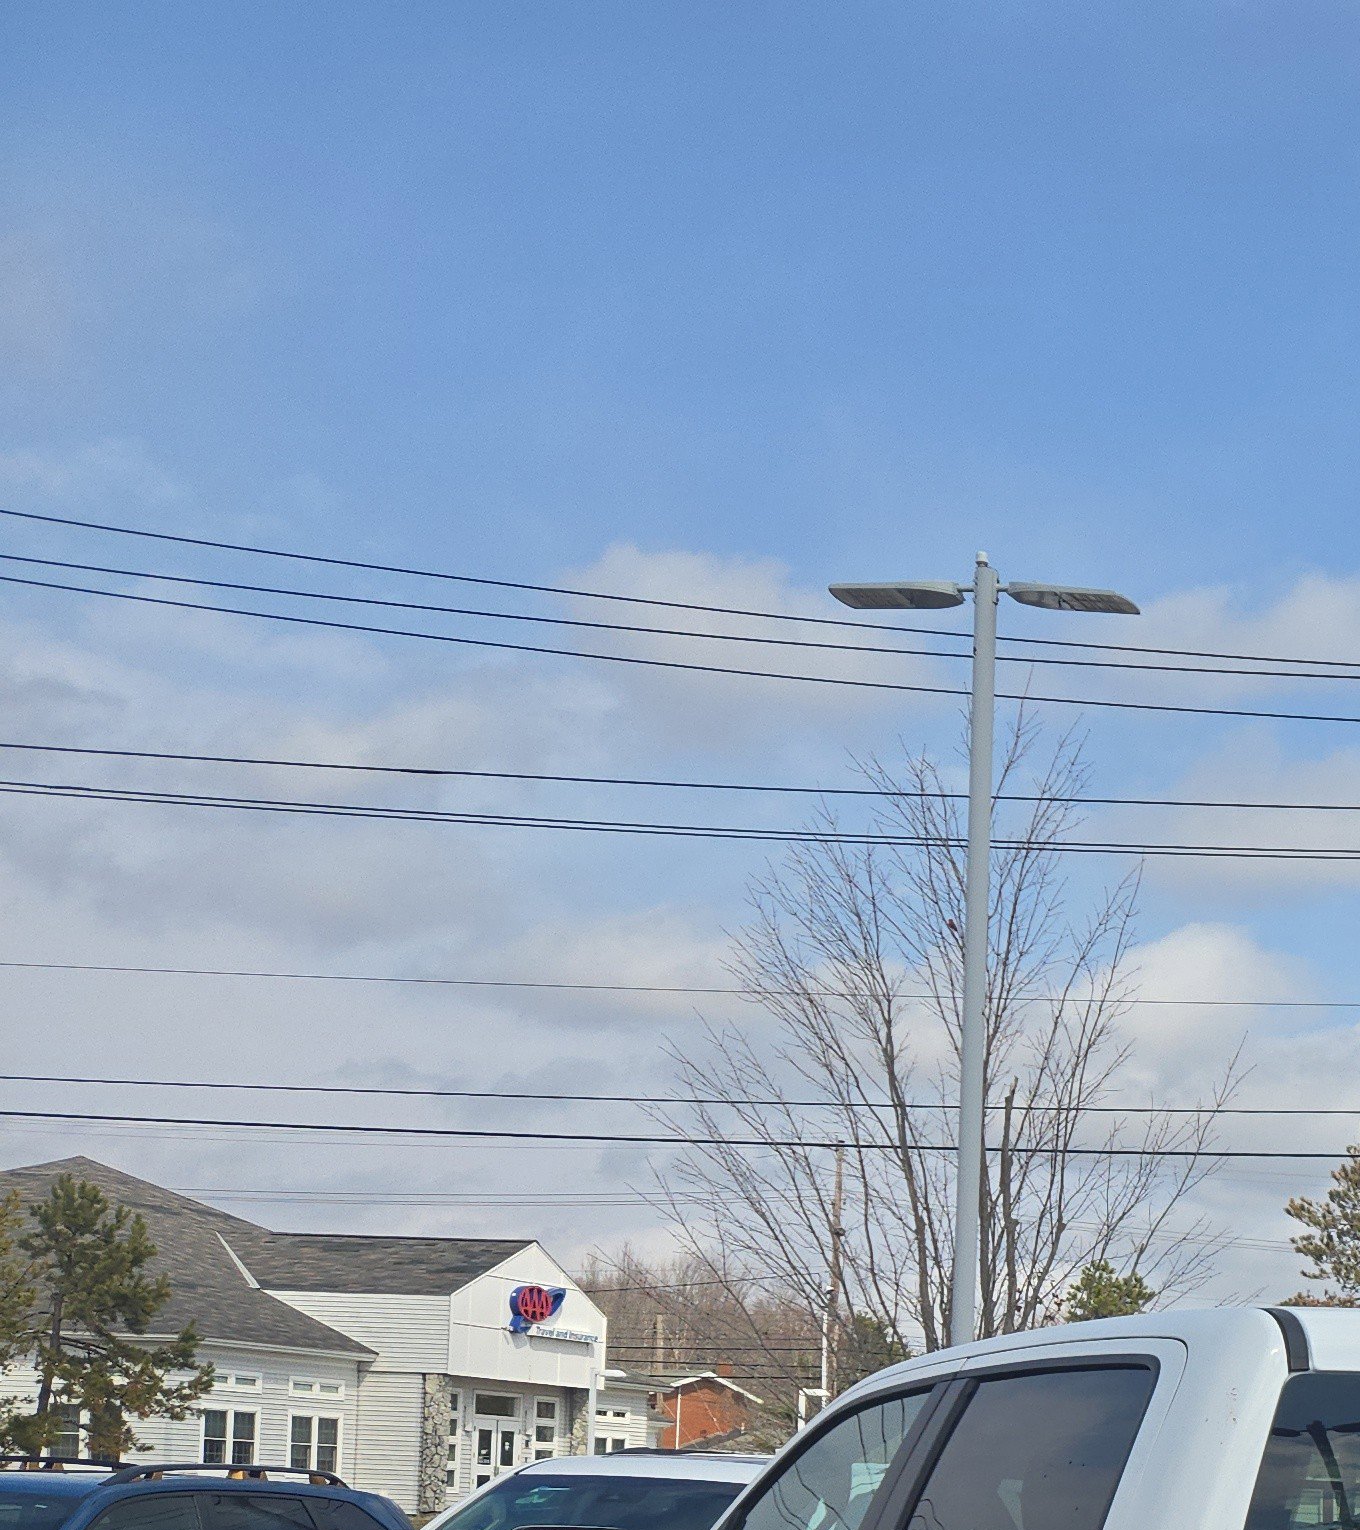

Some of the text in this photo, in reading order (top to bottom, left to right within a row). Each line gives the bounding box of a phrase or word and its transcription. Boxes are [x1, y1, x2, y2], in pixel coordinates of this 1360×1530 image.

[518, 1286, 552, 1322] AAA
[536, 1326, 555, 1337] Travel
[556, 1329, 568, 1339] and
